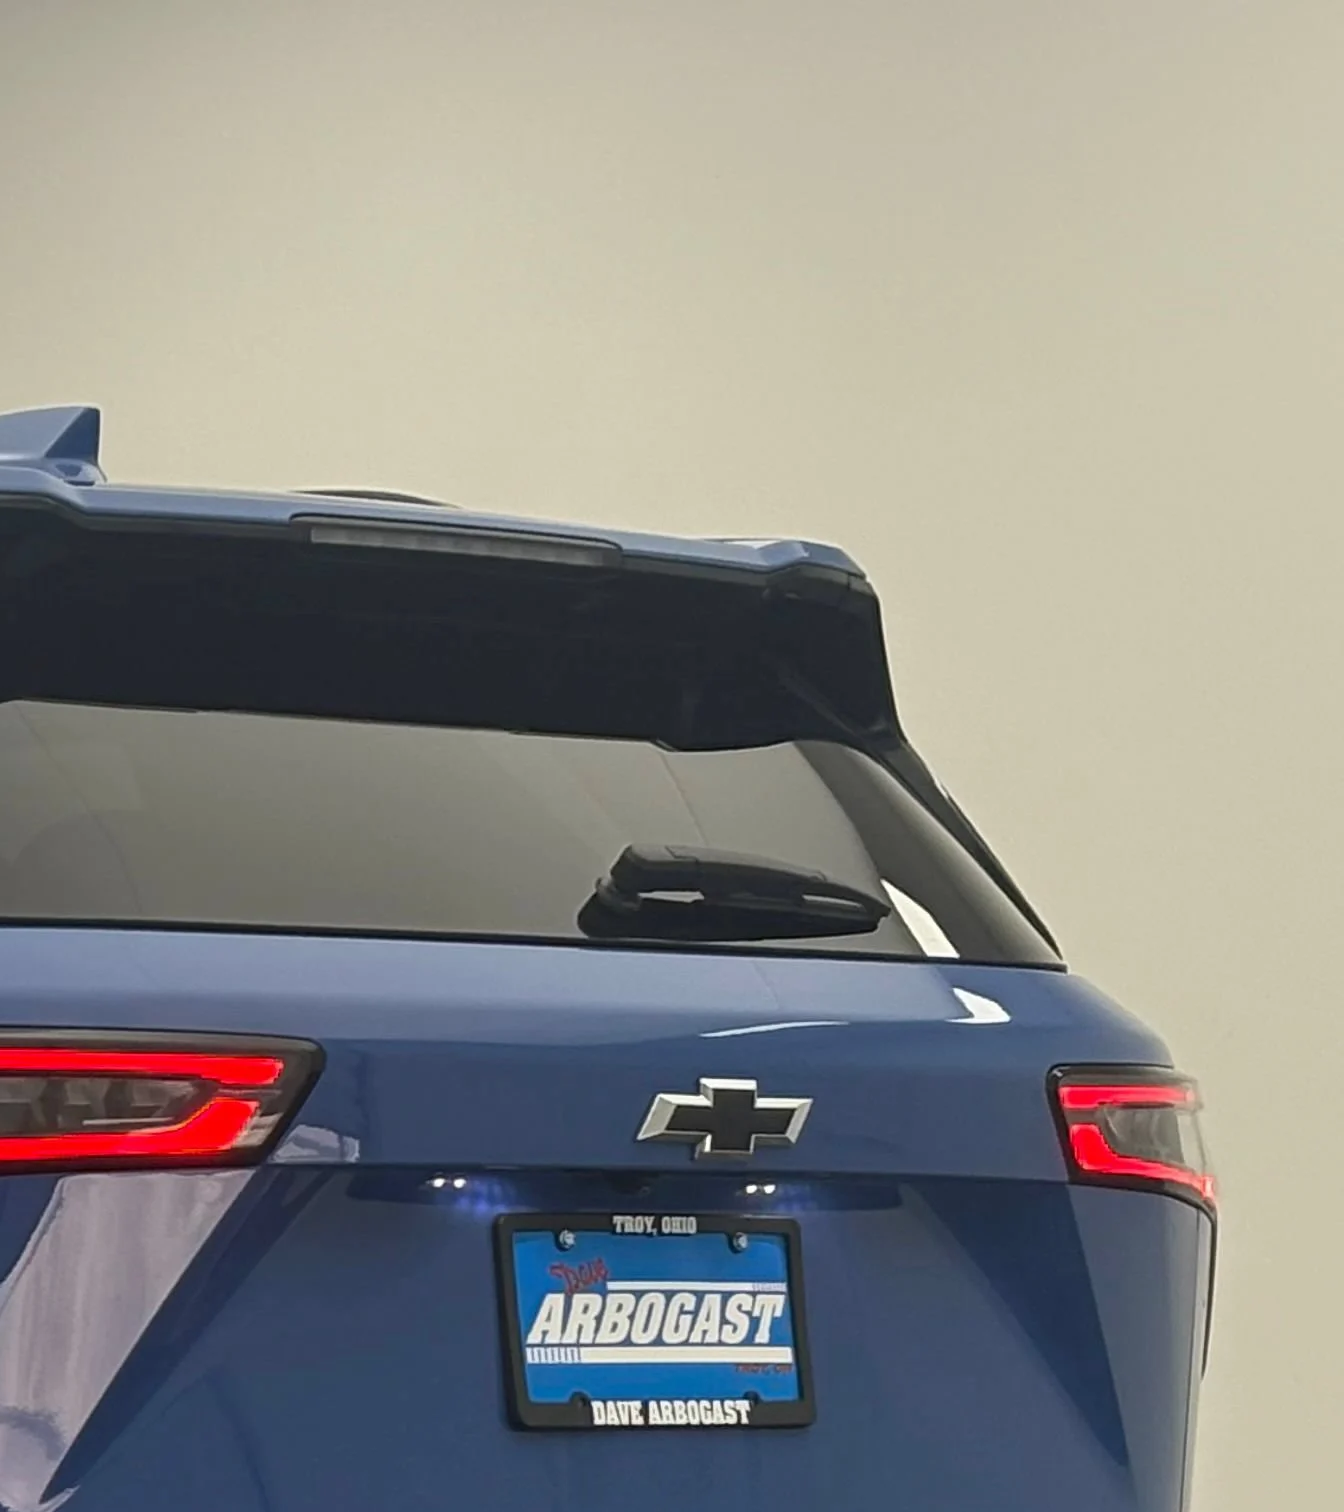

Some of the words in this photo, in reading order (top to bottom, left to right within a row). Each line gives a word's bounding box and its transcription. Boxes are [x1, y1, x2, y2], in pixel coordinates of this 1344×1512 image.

[613, 1215, 657, 1236] TROY,
[661, 1216, 697, 1234] OHIO
[548, 1258, 610, 1295] Dave
[526, 1292, 786, 1345] ARBOGAST
[591, 1400, 644, 1426] DAVE
[648, 1400, 752, 1425] ARBOGAST
